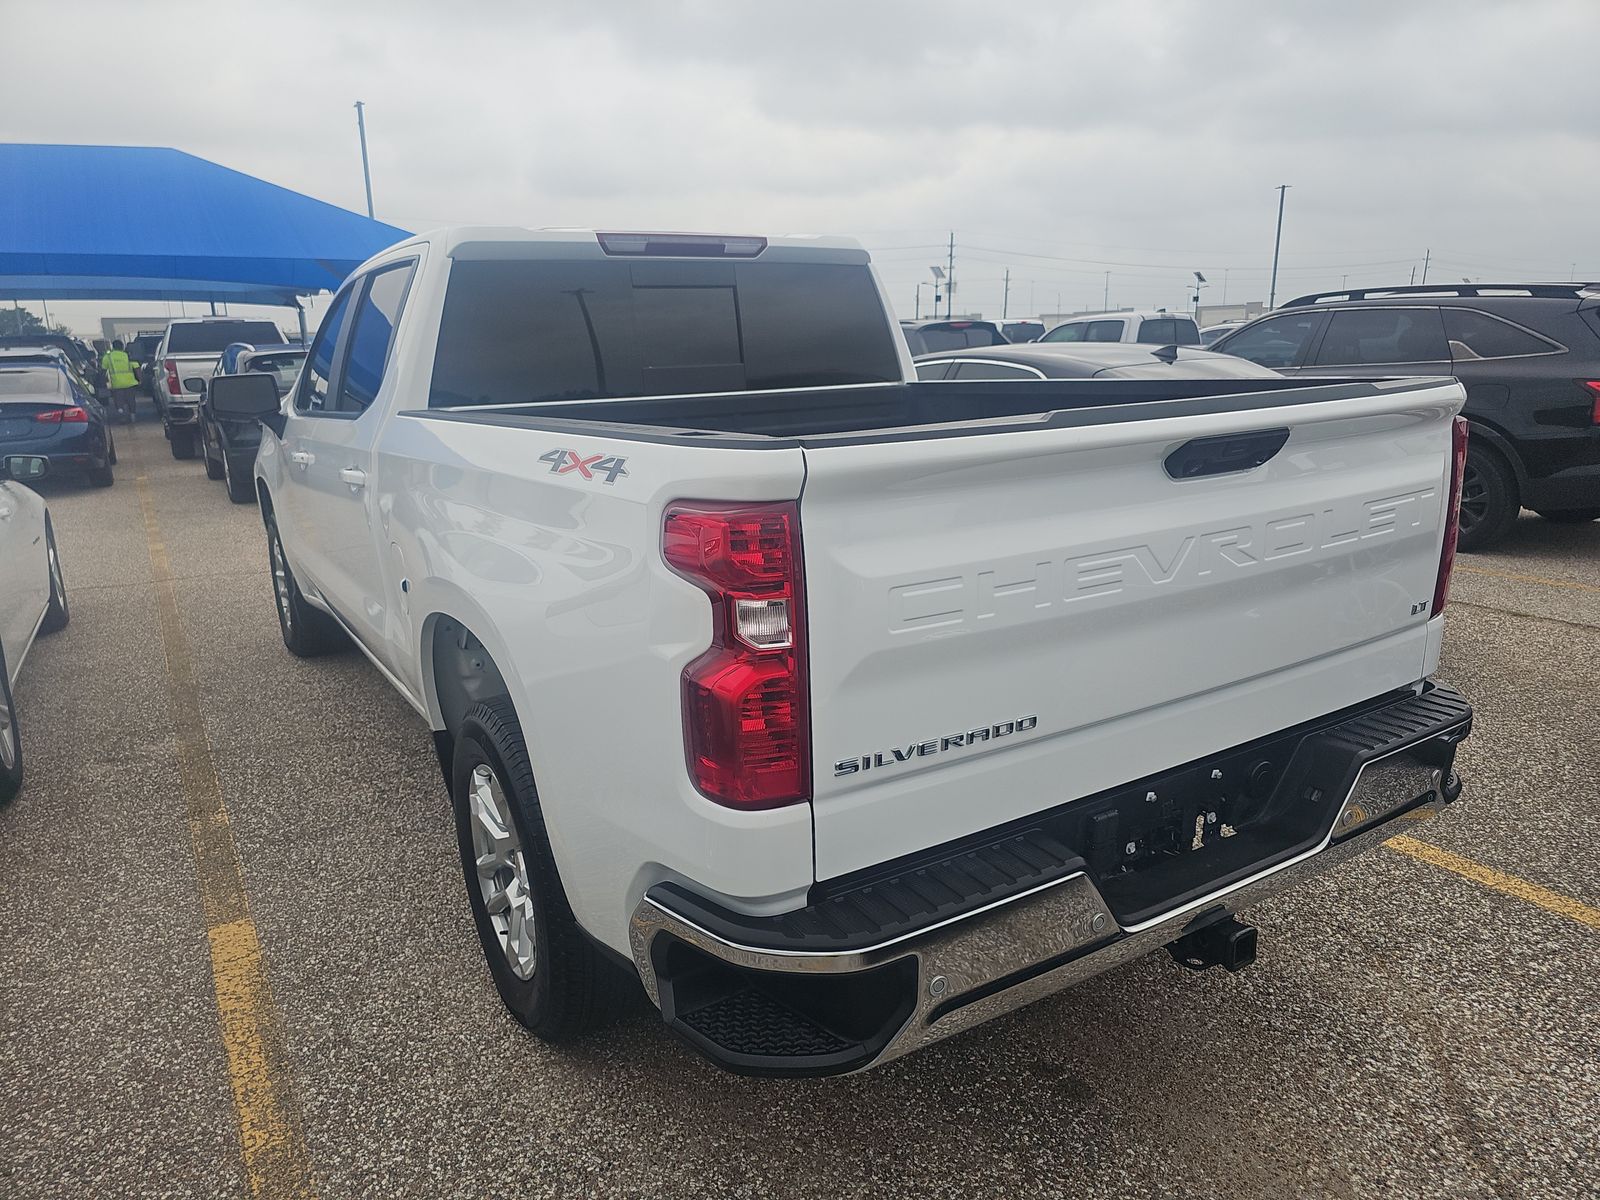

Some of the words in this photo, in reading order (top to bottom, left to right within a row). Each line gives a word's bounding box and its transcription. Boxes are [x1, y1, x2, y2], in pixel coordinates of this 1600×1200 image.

[888, 487, 1436, 634] CHEVROLET
[1411, 600, 1429, 616] LT
[834, 715, 1038, 777] SILVERADO
